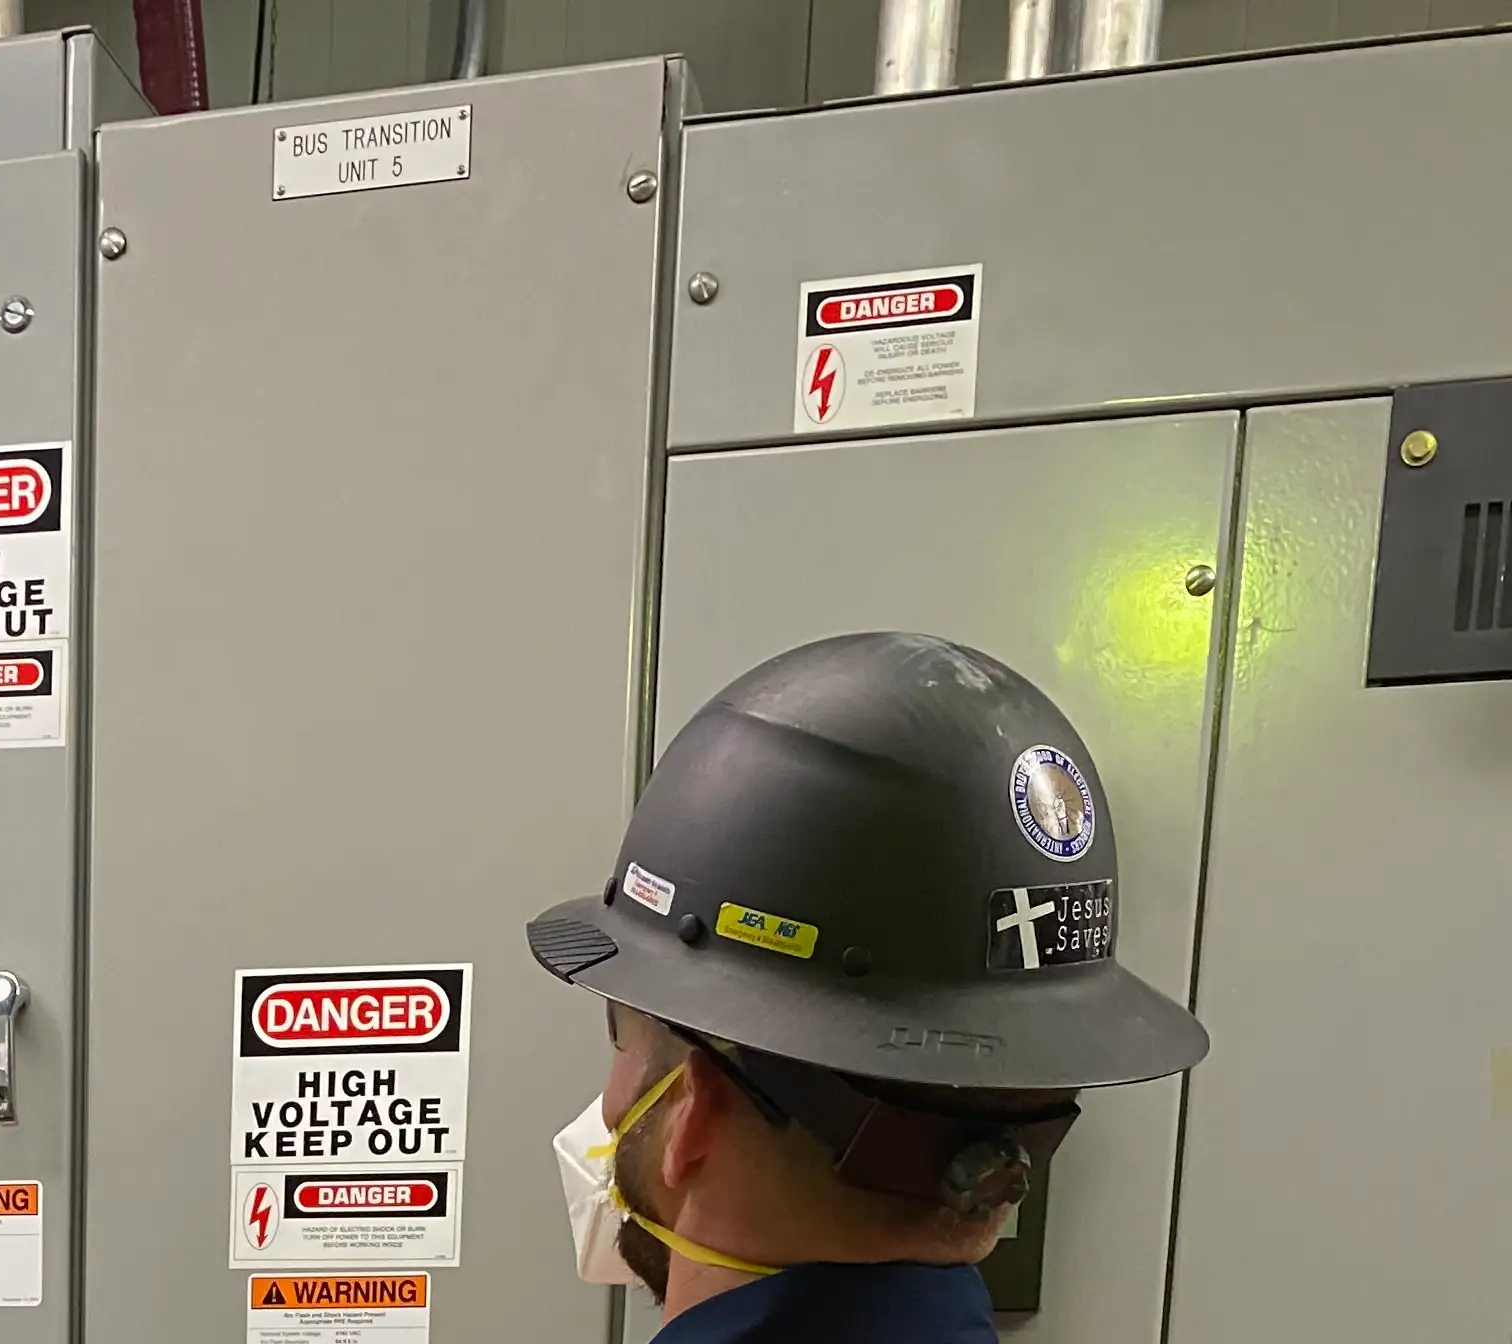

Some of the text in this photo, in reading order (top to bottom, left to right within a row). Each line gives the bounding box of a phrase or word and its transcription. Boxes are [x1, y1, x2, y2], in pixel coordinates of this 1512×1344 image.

[293, 117, 452, 157] BUS TRANSITION
[338, 155, 403, 184] UNIT 5
[840, 292, 936, 321] DANGER
[1057, 896, 1110, 922] Jesus
[1056, 923, 1109, 952] Saves
[266, 994, 435, 1033] DANGER
[297, 1069, 396, 1098] HIGH
[252, 1098, 441, 1129] VOLTAGE
[244, 1127, 450, 1158] KEEP OUT
[318, 1186, 412, 1205] DANGER
[293, 1279, 417, 1304] WARNING
